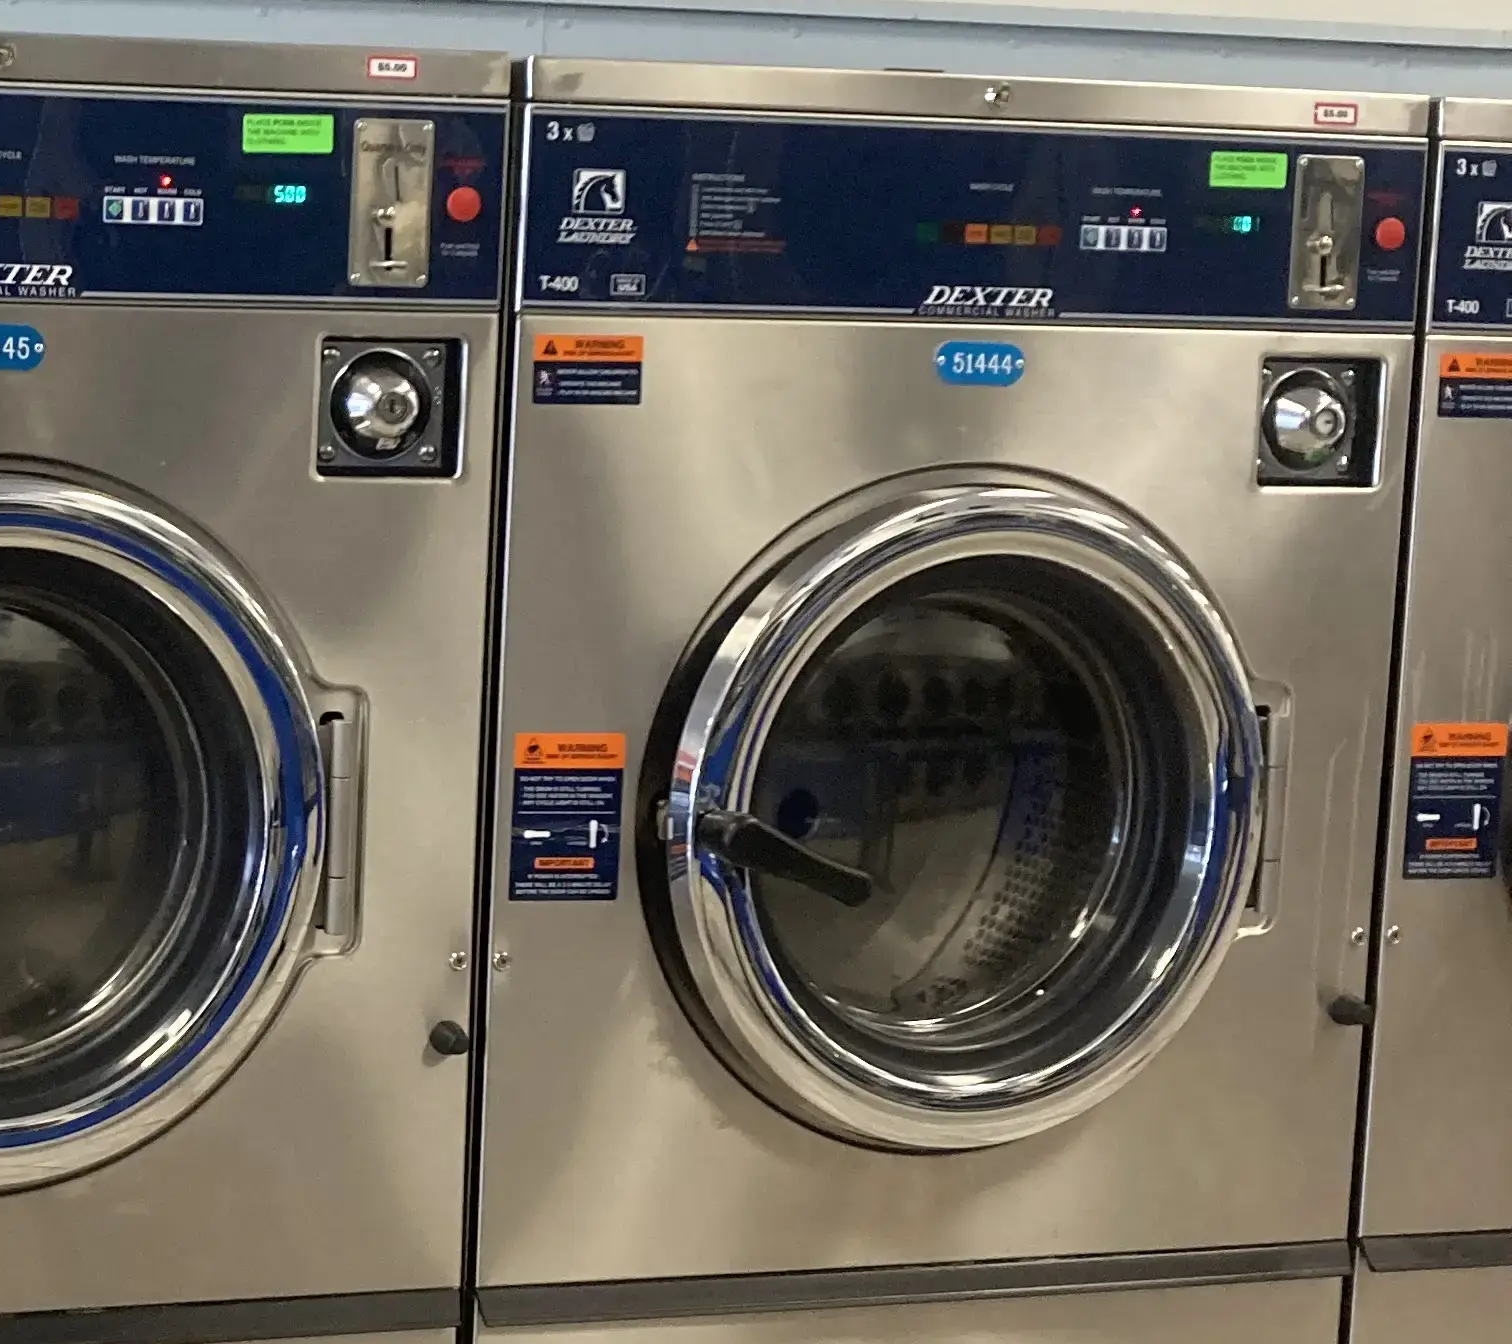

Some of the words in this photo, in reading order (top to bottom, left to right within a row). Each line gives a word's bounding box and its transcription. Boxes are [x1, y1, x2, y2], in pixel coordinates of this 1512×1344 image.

[546, 121, 560, 141] 3
[1456, 158, 1467, 176] 3
[559, 217, 634, 231] DEXTER
[18, 285, 76, 298] WASHER
[539, 275, 579, 292] T-400
[923, 285, 1053, 308] DEXTER
[918, 306, 999, 317] COMMERCIAL
[1005, 308, 1055, 319] WASHER
[1447, 299, 1479, 314] T-400
[952, 352, 1013, 375] 51444
